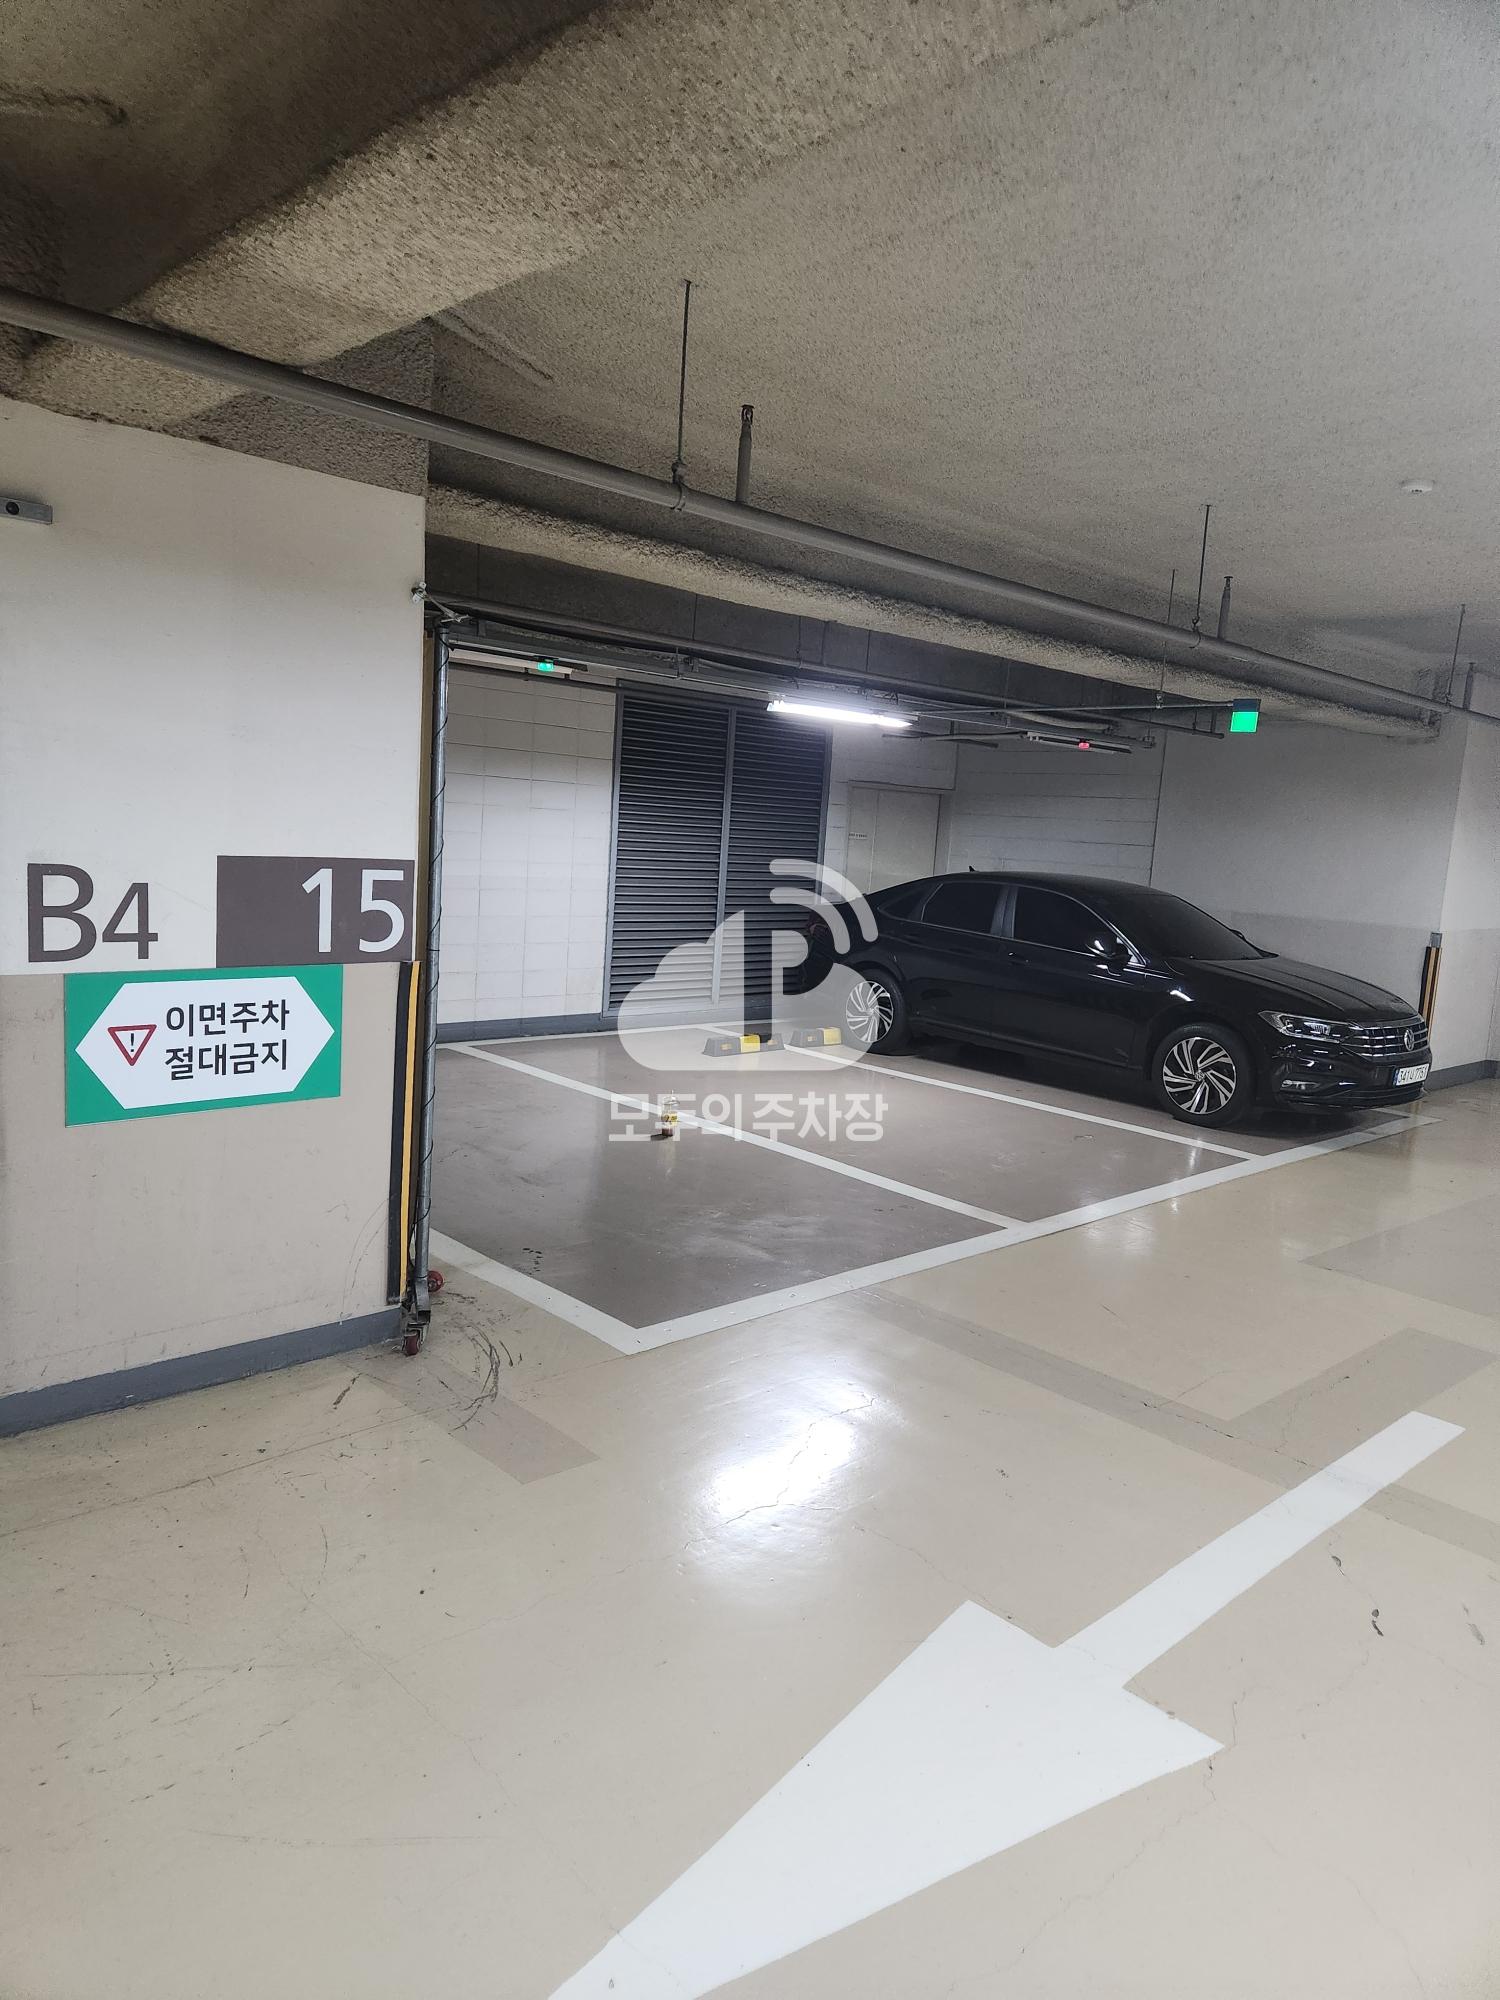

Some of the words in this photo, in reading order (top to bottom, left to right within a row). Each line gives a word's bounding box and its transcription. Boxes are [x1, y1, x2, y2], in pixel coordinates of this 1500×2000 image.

[27, 863, 159, 962] B4
[302, 868, 405, 953] 15
[165, 998, 290, 1036] 이면주차
[164, 1038, 288, 1081] 절대금지
